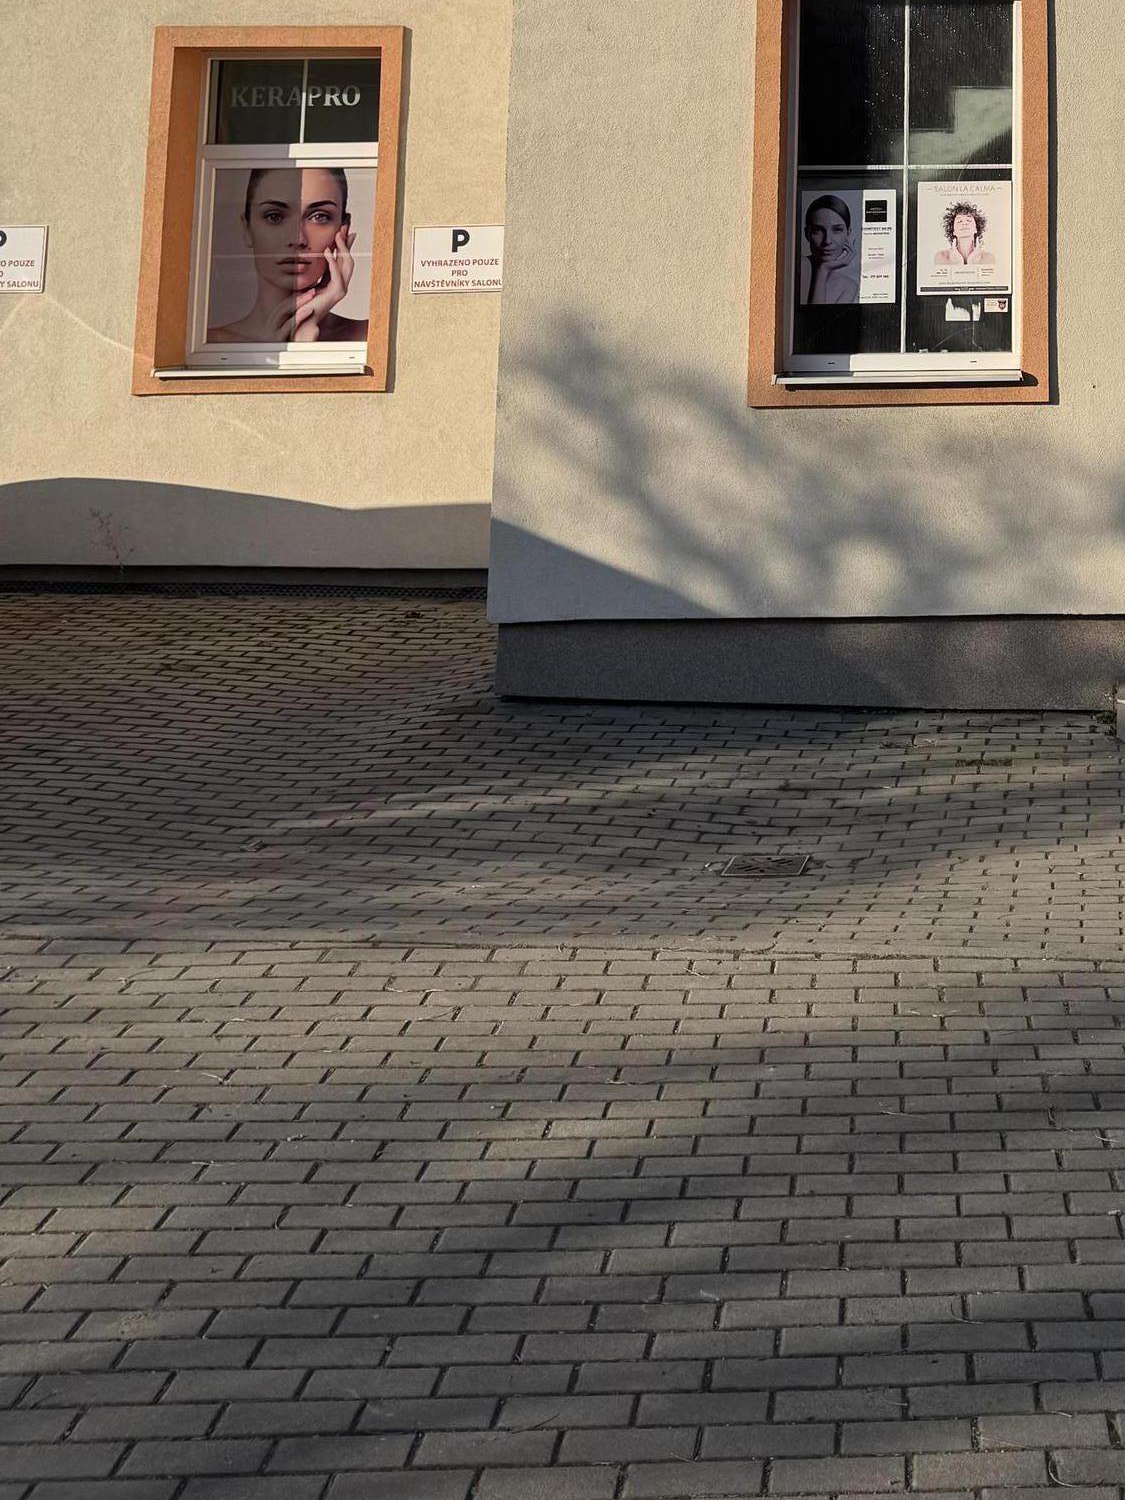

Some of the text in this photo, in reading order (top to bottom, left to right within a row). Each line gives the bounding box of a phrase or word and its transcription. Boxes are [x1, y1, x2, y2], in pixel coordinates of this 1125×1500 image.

[451, 229, 470, 253] P
[8, 260, 35, 268] POUZE
[421, 258, 500, 268] VYHRAZENO POUZE
[451, 269, 469, 277] PRO
[7, 280, 39, 288] SALONU
[414, 279, 469, 288] NÁVŠTĚVNÍKY
